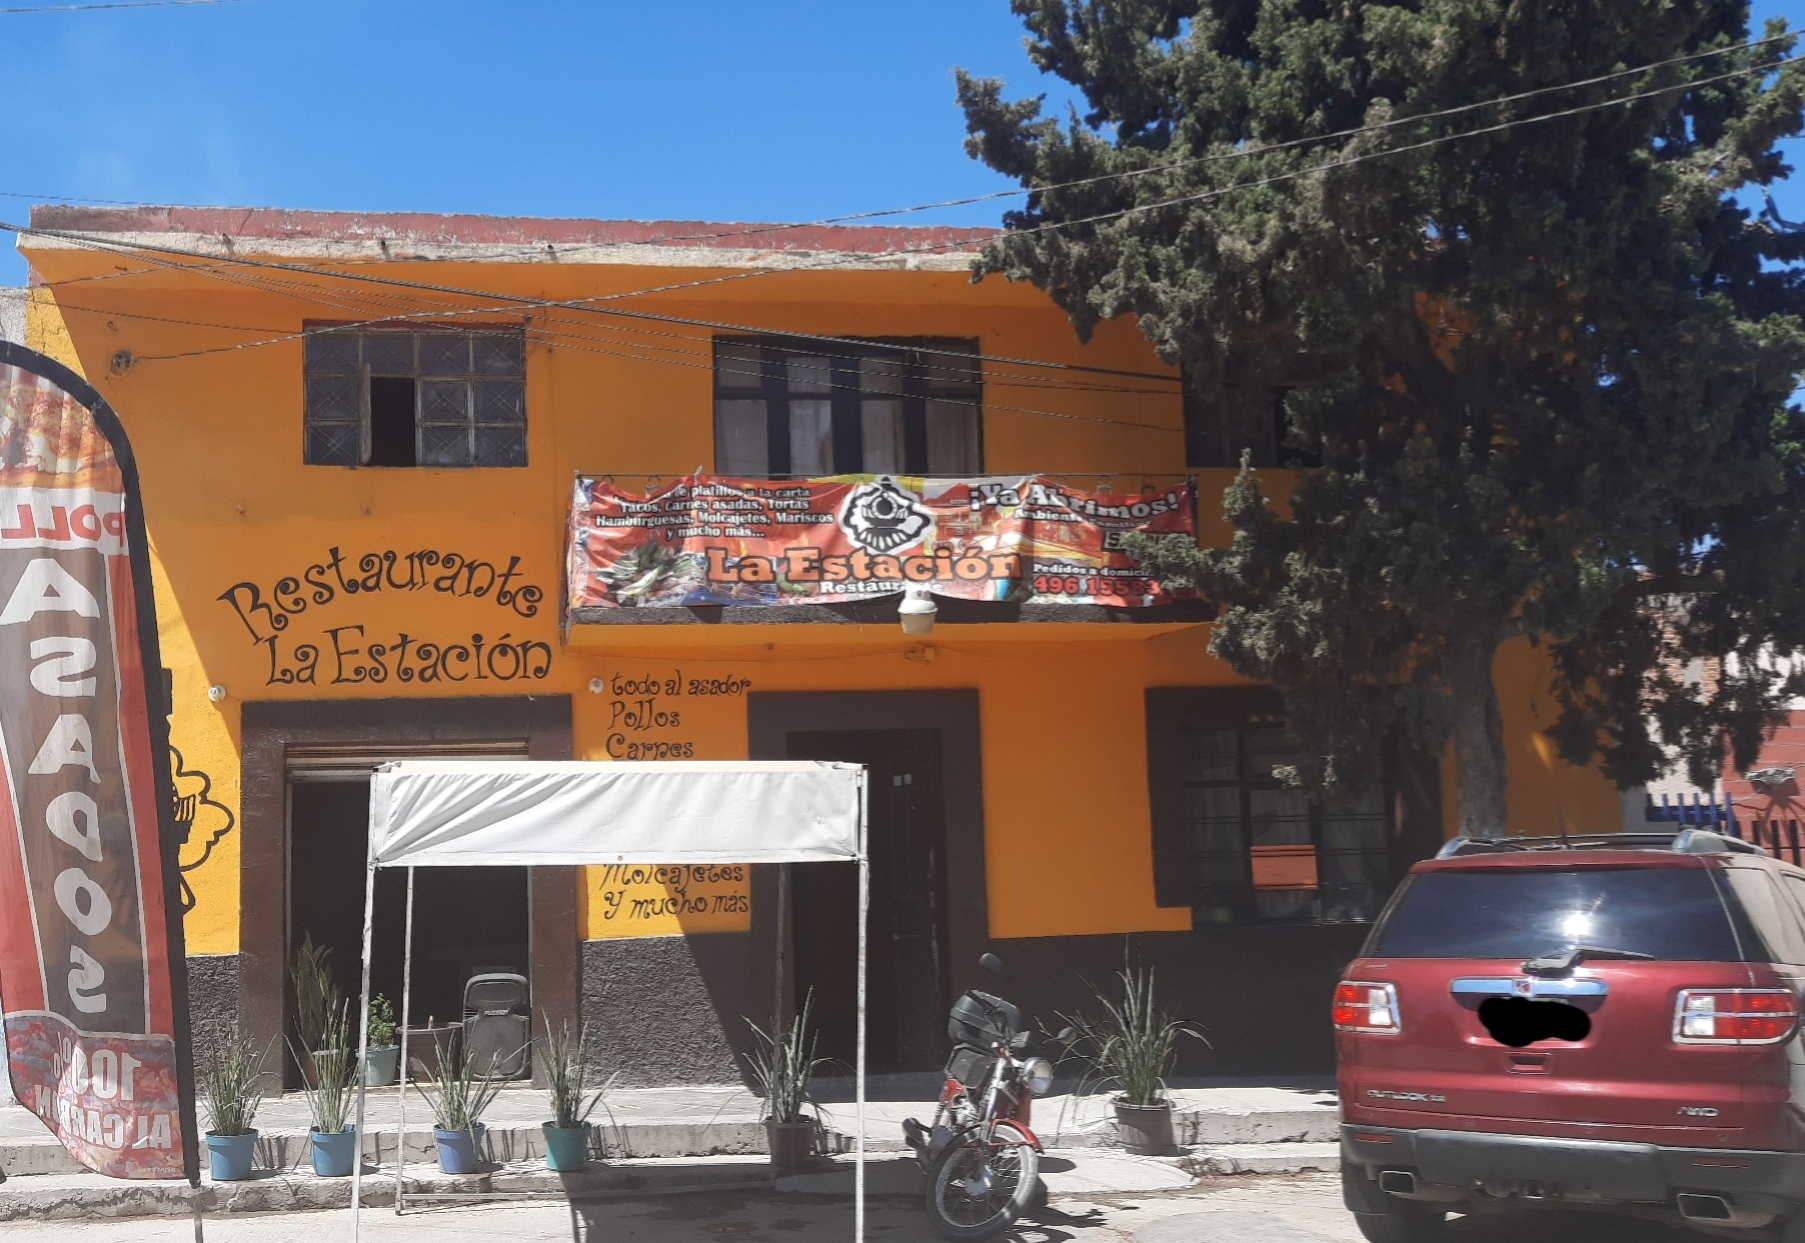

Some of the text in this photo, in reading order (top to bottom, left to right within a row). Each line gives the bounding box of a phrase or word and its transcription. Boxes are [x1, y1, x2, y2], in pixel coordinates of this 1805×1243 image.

[691, 484, 743, 498] platillos
[776, 488, 811, 497] carta
[1027, 483, 1179, 519] Abrimos!
[595, 511, 834, 527] Hamburguesas, Molcajetes, Mariscos
[665, 500, 708, 511] Carnes
[712, 500, 763, 510] asadas,
[767, 500, 809, 510] Tortas
[667, 529, 674, 540] y
[678, 525, 721, 537] mucho
[706, 547, 1022, 583] La Estación
[1033, 563, 1086, 575] Pedidos
[1089, 568, 1098, 576] a
[216, 547, 543, 646] Restaurante
[1033, 576, 1079, 594] 496
[263, 625, 552, 686] La Estación
[610, 669, 751, 697] todo al asador
[607, 698, 680, 731] Pollos
[606, 733, 694, 760] Carnes
[629, 891, 707, 919] mucho
[711, 889, 749, 914] más
[1676, 1106, 1719, 1117] AWD
